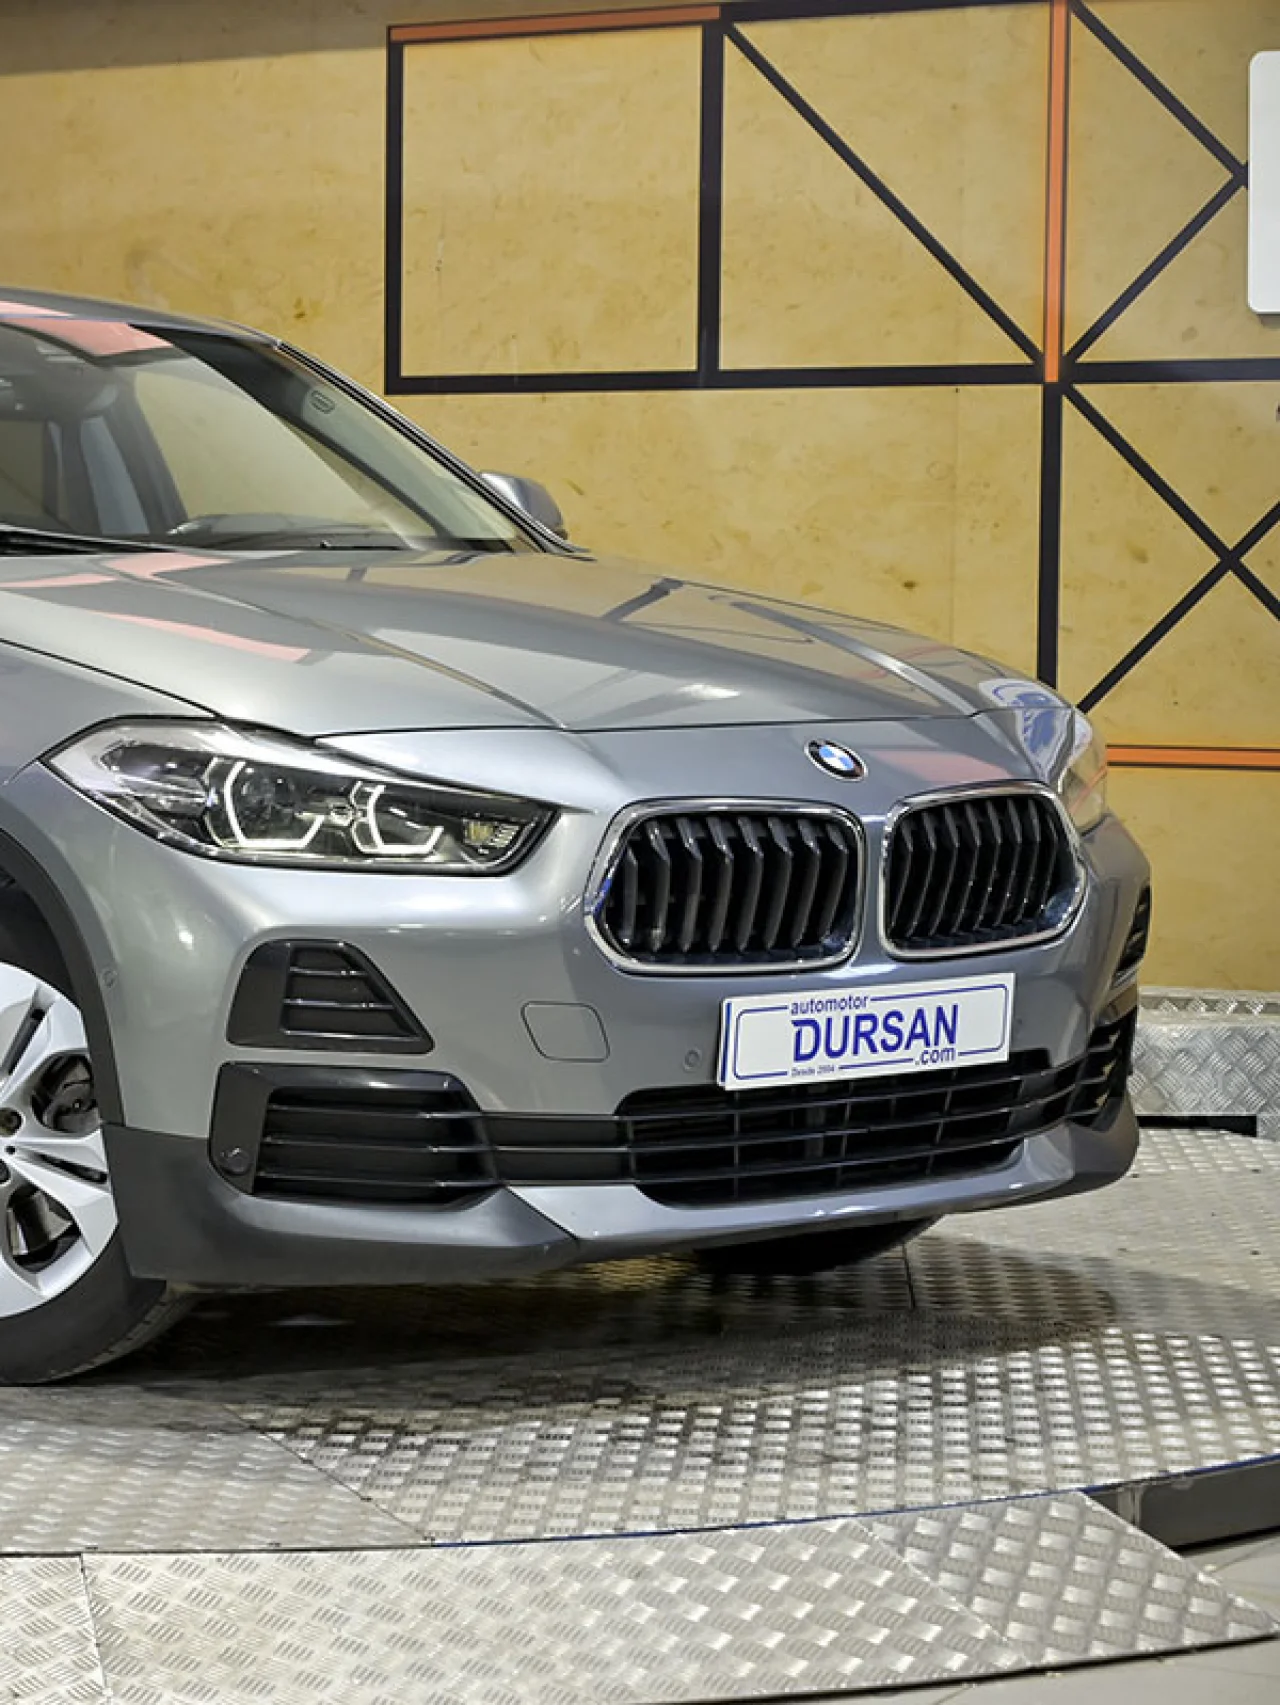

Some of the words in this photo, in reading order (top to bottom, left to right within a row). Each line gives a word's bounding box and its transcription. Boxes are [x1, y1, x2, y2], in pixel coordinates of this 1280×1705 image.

[790, 994, 869, 1015] automotor
[791, 1004, 959, 1062] DURSAN
[914, 1047, 955, 1066] .com
